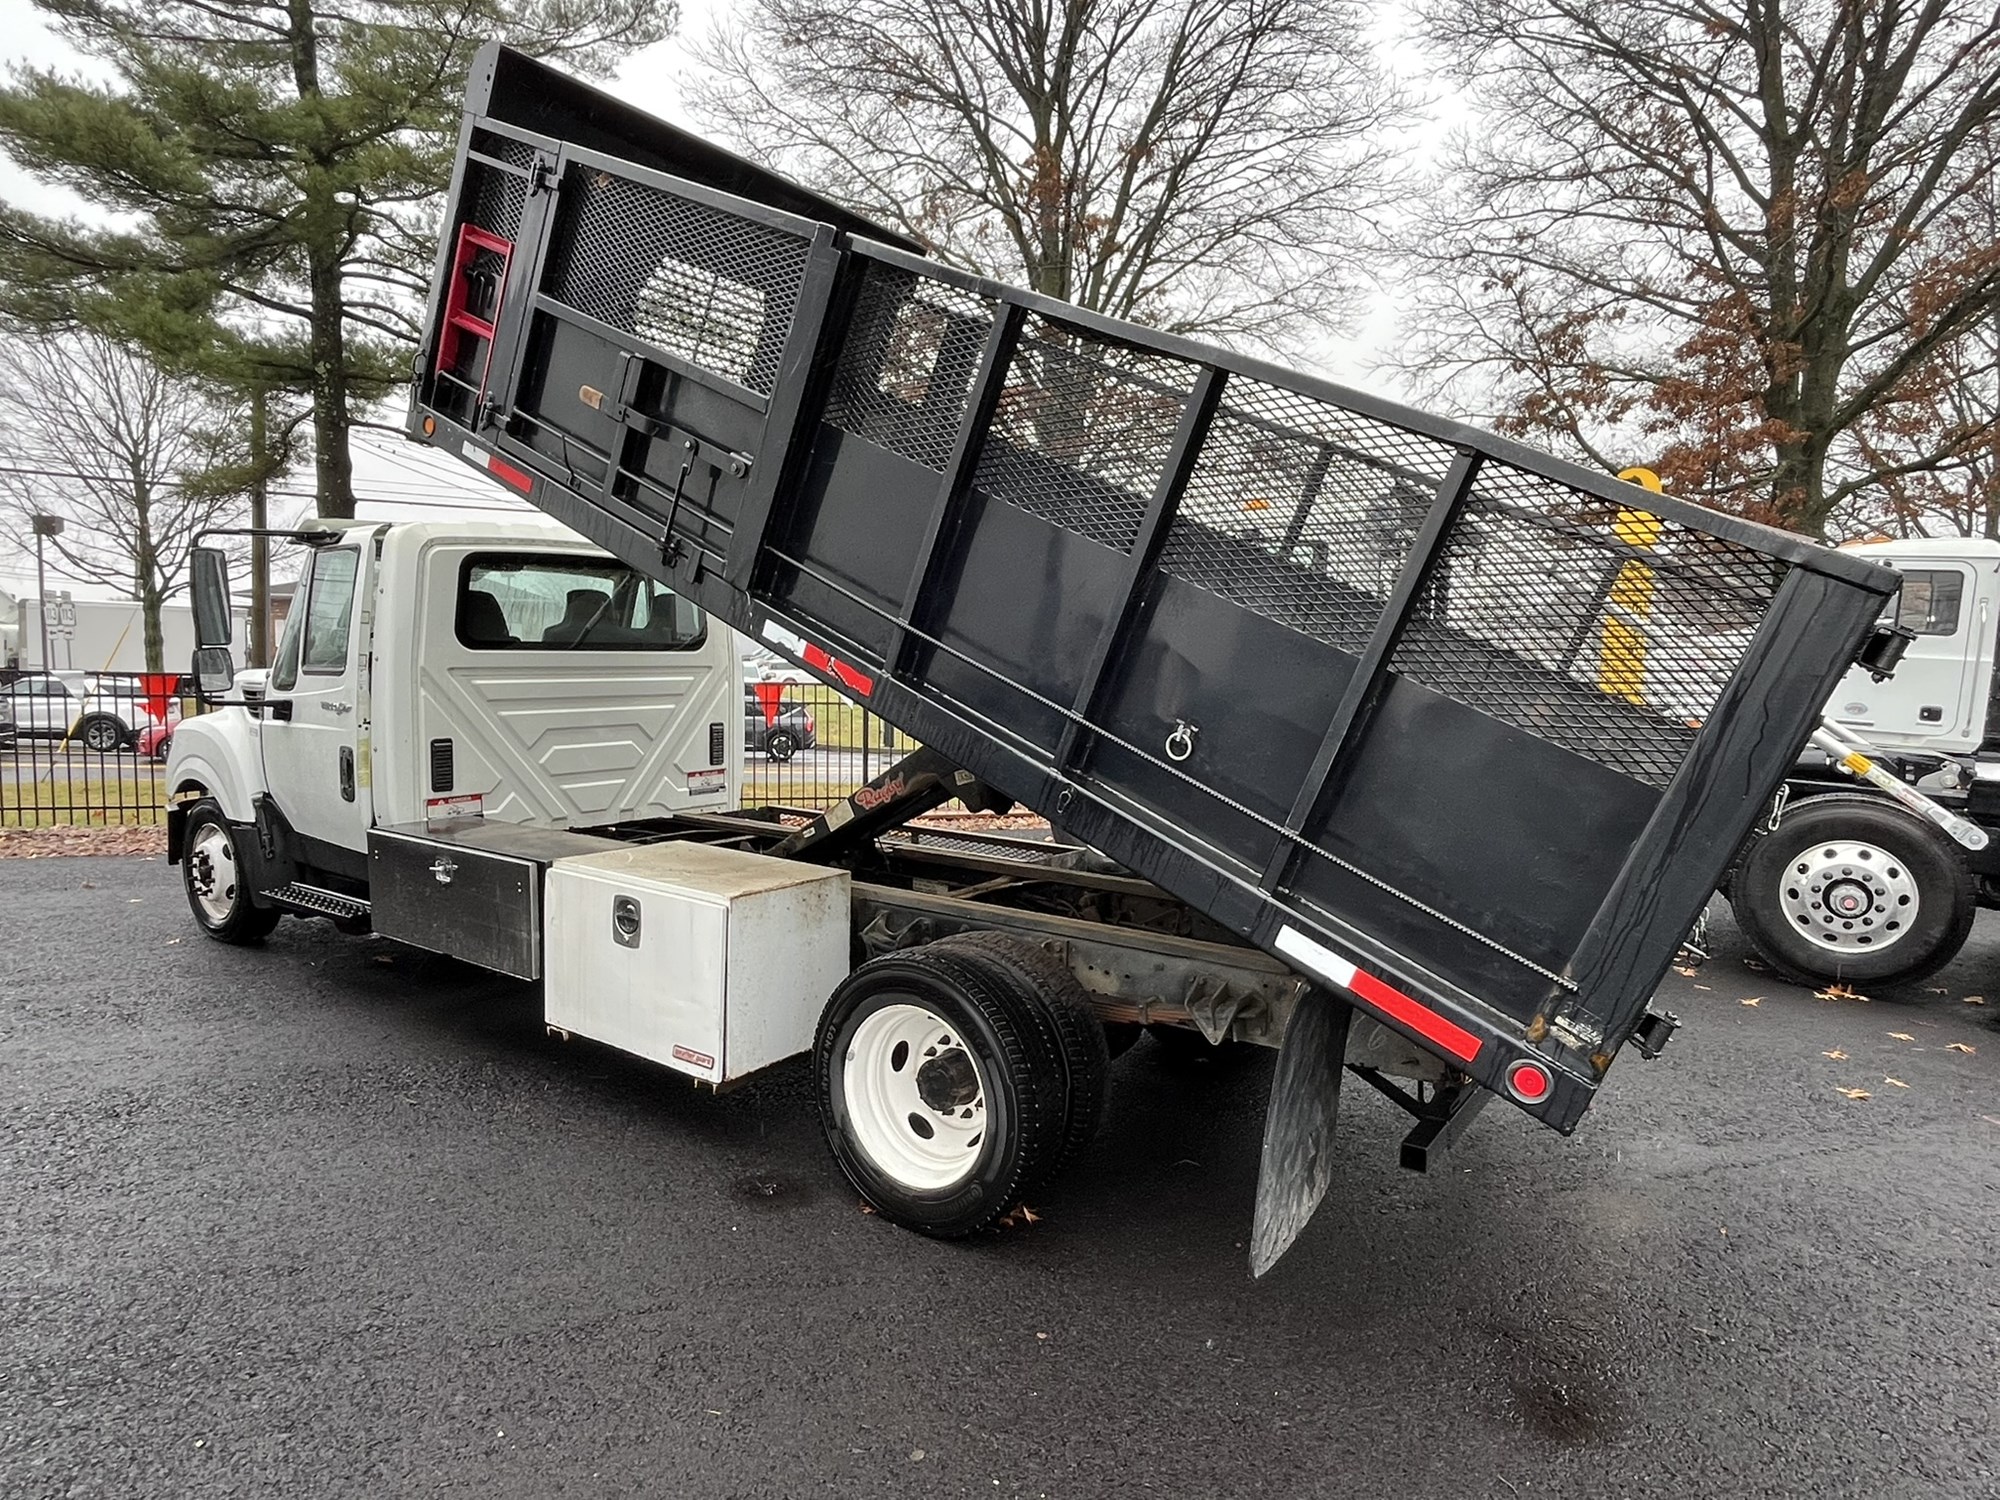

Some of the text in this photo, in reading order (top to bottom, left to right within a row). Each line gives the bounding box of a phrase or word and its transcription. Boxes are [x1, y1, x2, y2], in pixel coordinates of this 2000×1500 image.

[46, 608, 56, 621] 113
[62, 608, 73, 621] 113
[854, 771, 904, 809] Rugby
